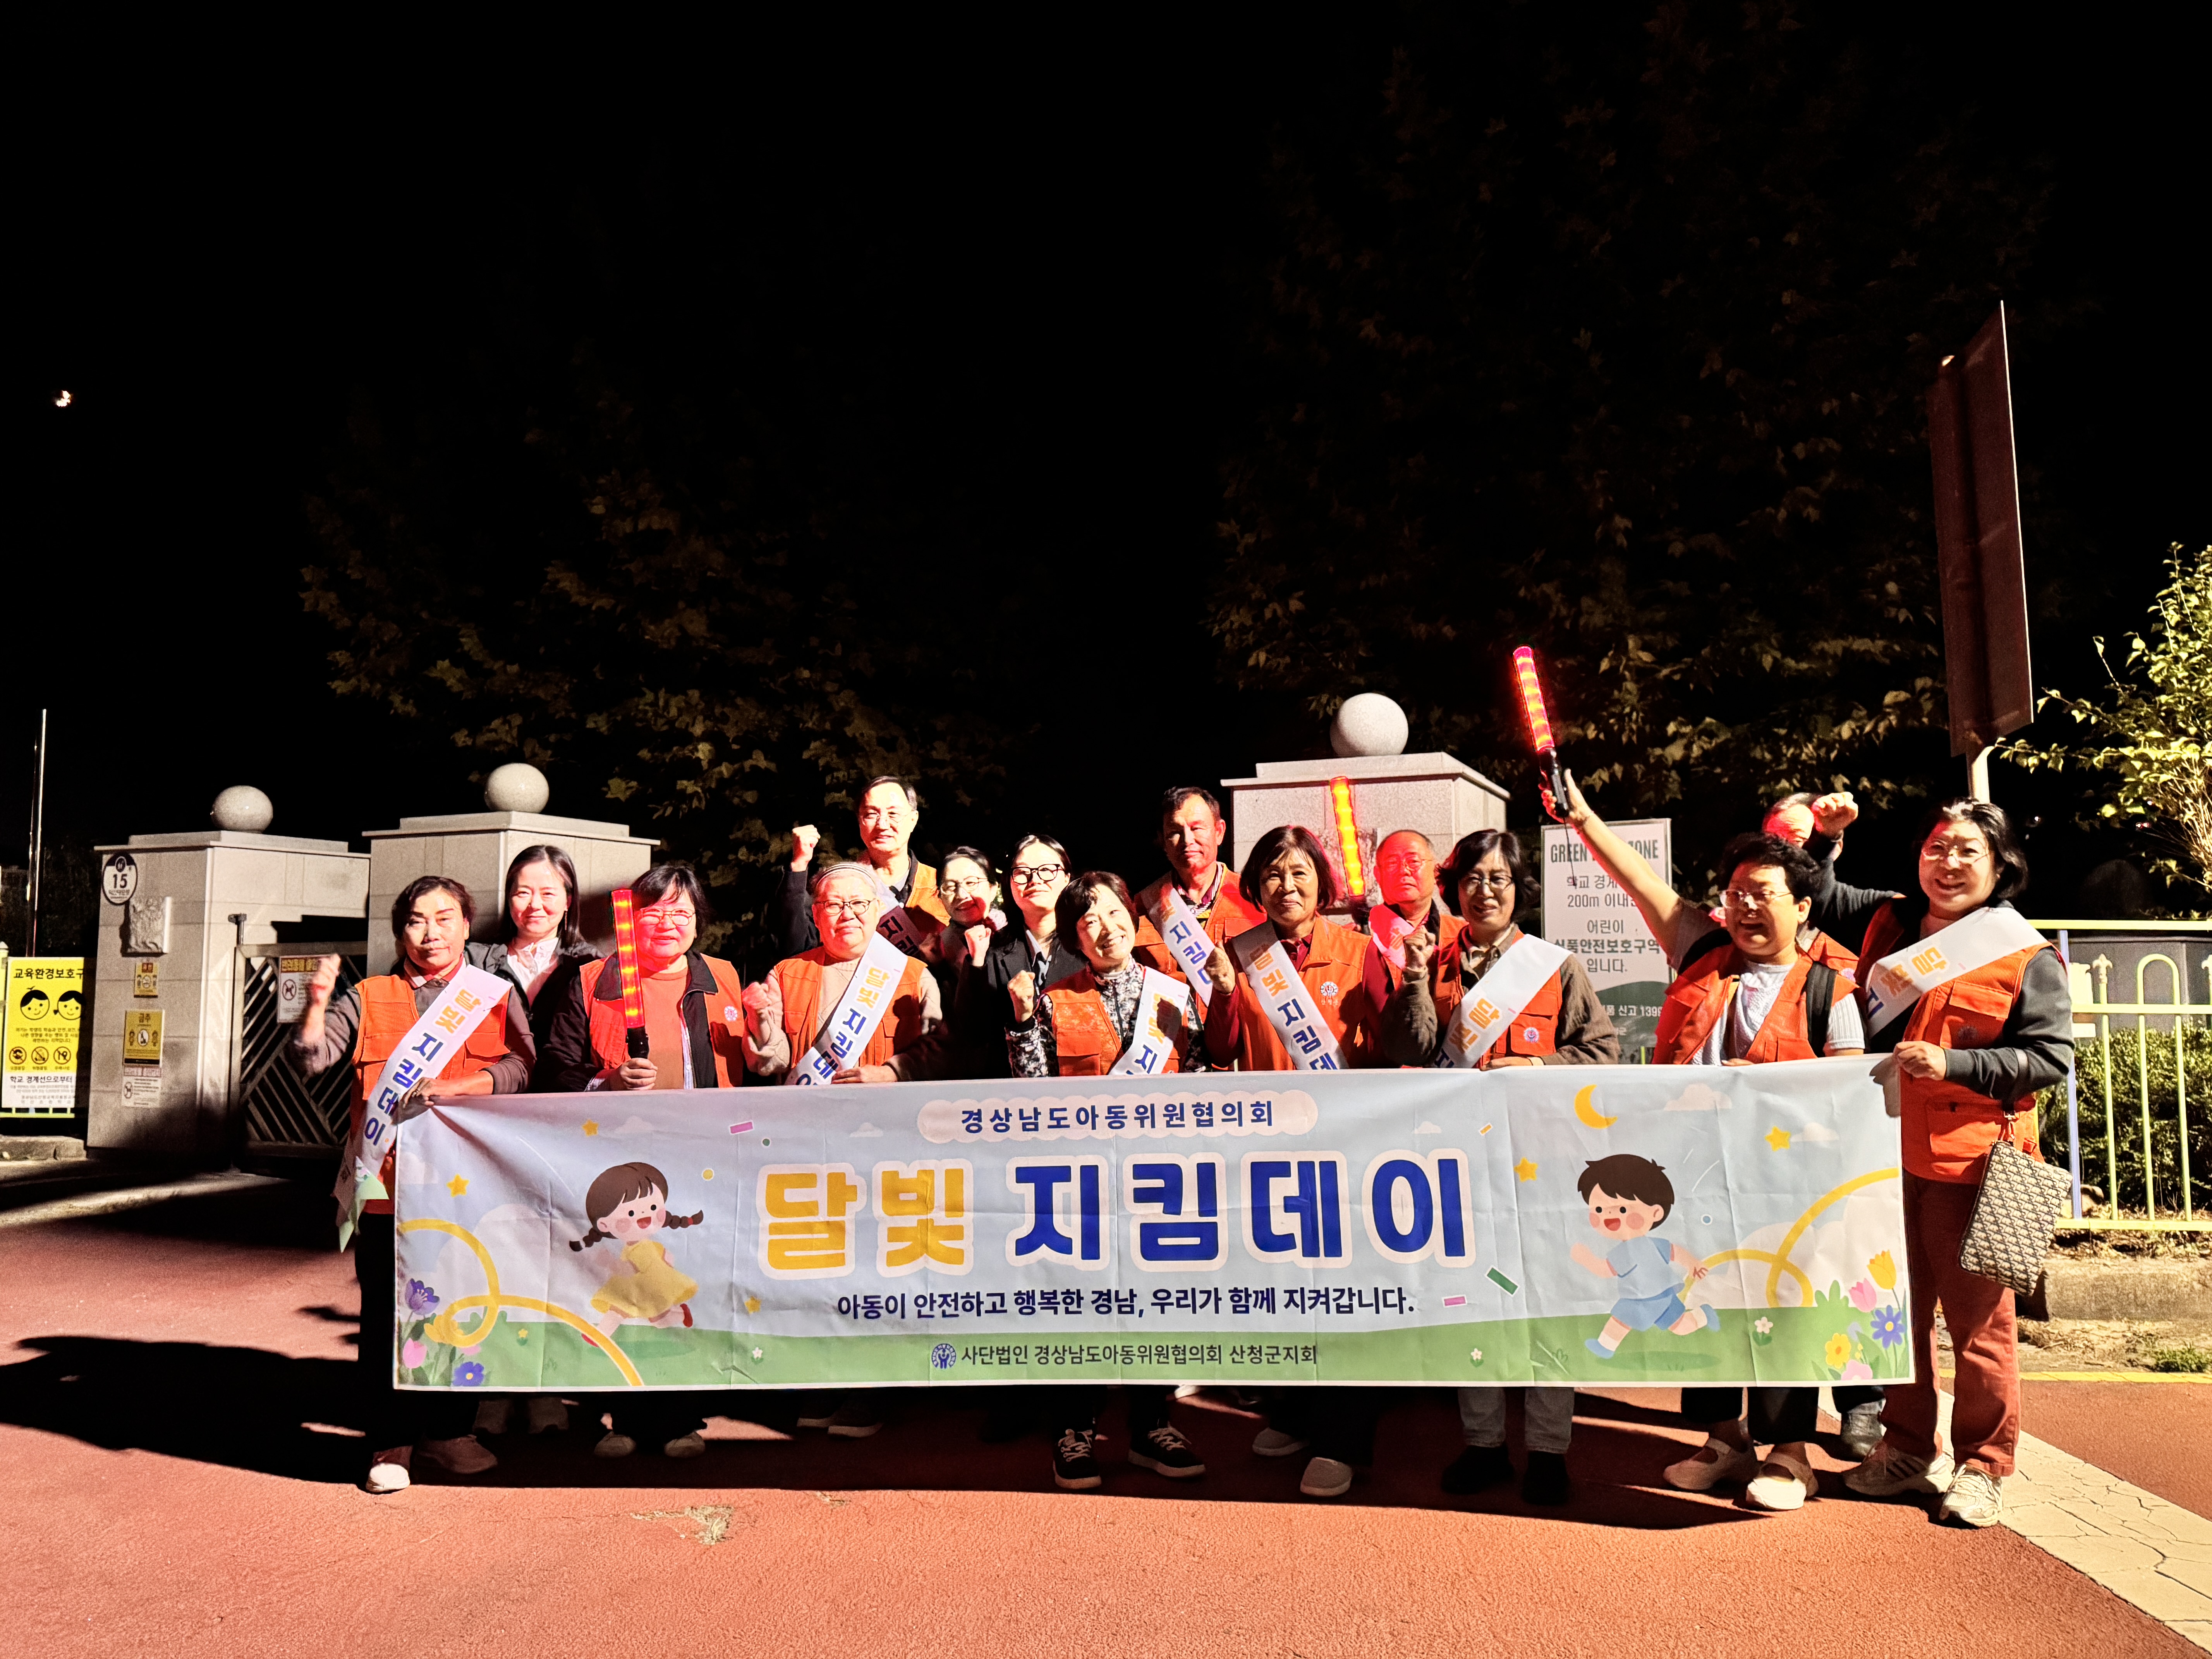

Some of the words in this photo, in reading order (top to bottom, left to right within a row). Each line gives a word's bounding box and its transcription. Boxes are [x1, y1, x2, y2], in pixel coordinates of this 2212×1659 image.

[1551, 843, 1587, 862] GREEN
[113, 874, 127, 888] 15
[1567, 875, 1589, 889] 학교
[1568, 895, 1599, 907] 200m
[1587, 919, 1623, 934] 어린이
[14, 968, 83, 979] 교육환경보호구
[1587, 958, 1628, 973] 입니다.
[856, 967, 890, 1009] 달빛
[435, 989, 483, 1034] 달빛
[1618, 1005, 1637, 1016] 신고
[1449, 998, 1500, 1054] 달빛
[961, 1100, 1273, 1133] 경상남도아동위원협의회
[765, 1168, 965, 1270] 달빛
[1015, 1159, 1467, 1262] 지킴데이
[838, 1293, 905, 1319] 아동이
[914, 1291, 1007, 1319] 안전하고
[1013, 1289, 1084, 1316] 행복한
[1091, 1288, 1144, 1317] 경남,
[1151, 1287, 1222, 1315] 우리가
[1228, 1287, 1275, 1315] 함께
[1283, 1287, 1414, 1315] 지켜갑니다.
[961, 1345, 1028, 1365] 사단법인
[1034, 1344, 1222, 1365] 경상남도아동위원협의회
[1229, 1344, 1317, 1365] 산청군지회
